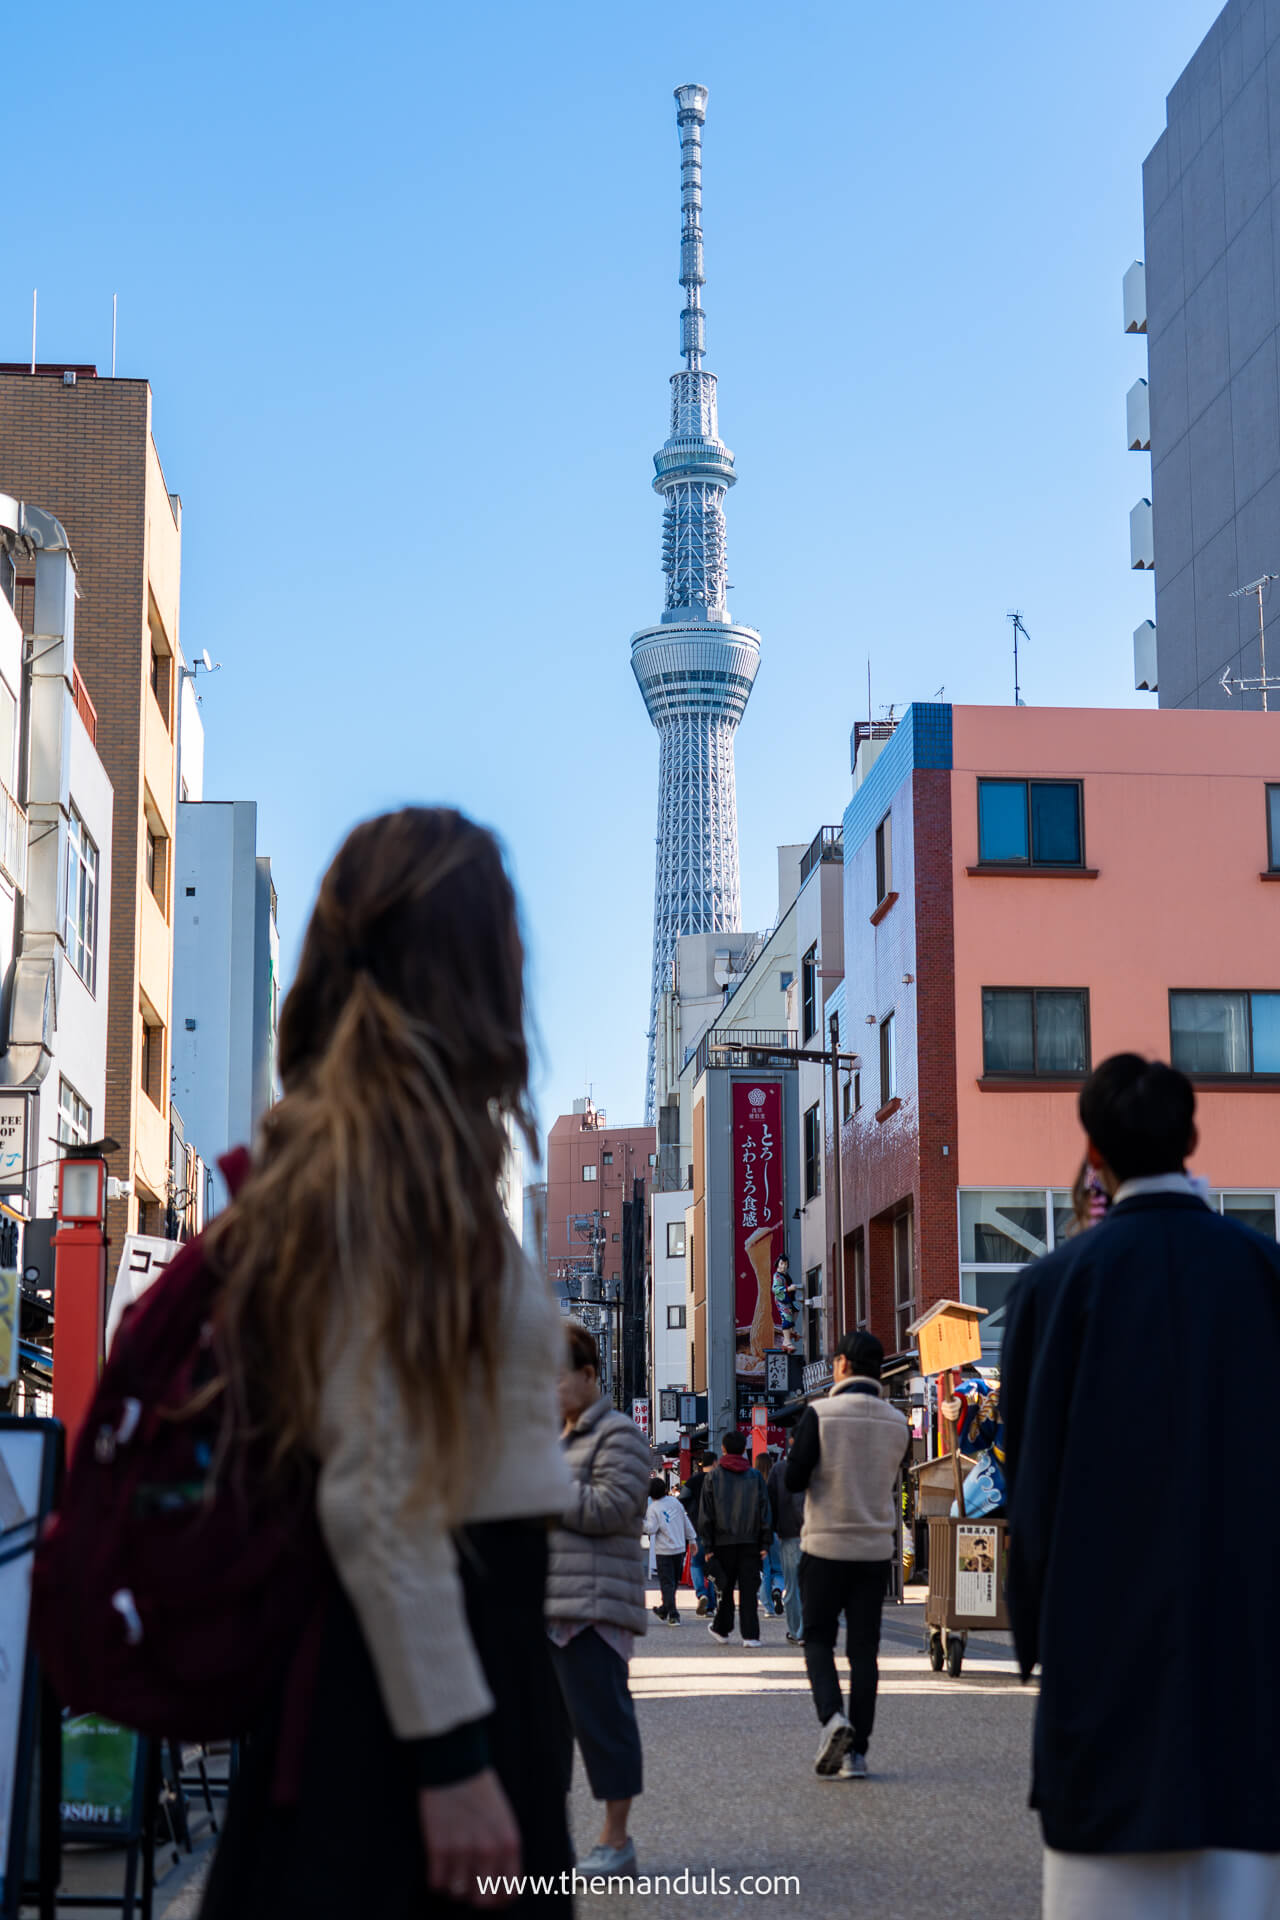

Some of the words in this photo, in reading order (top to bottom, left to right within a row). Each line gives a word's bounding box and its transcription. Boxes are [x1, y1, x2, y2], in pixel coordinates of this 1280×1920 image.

[741, 1136, 757, 1227] ふわとろ食感
